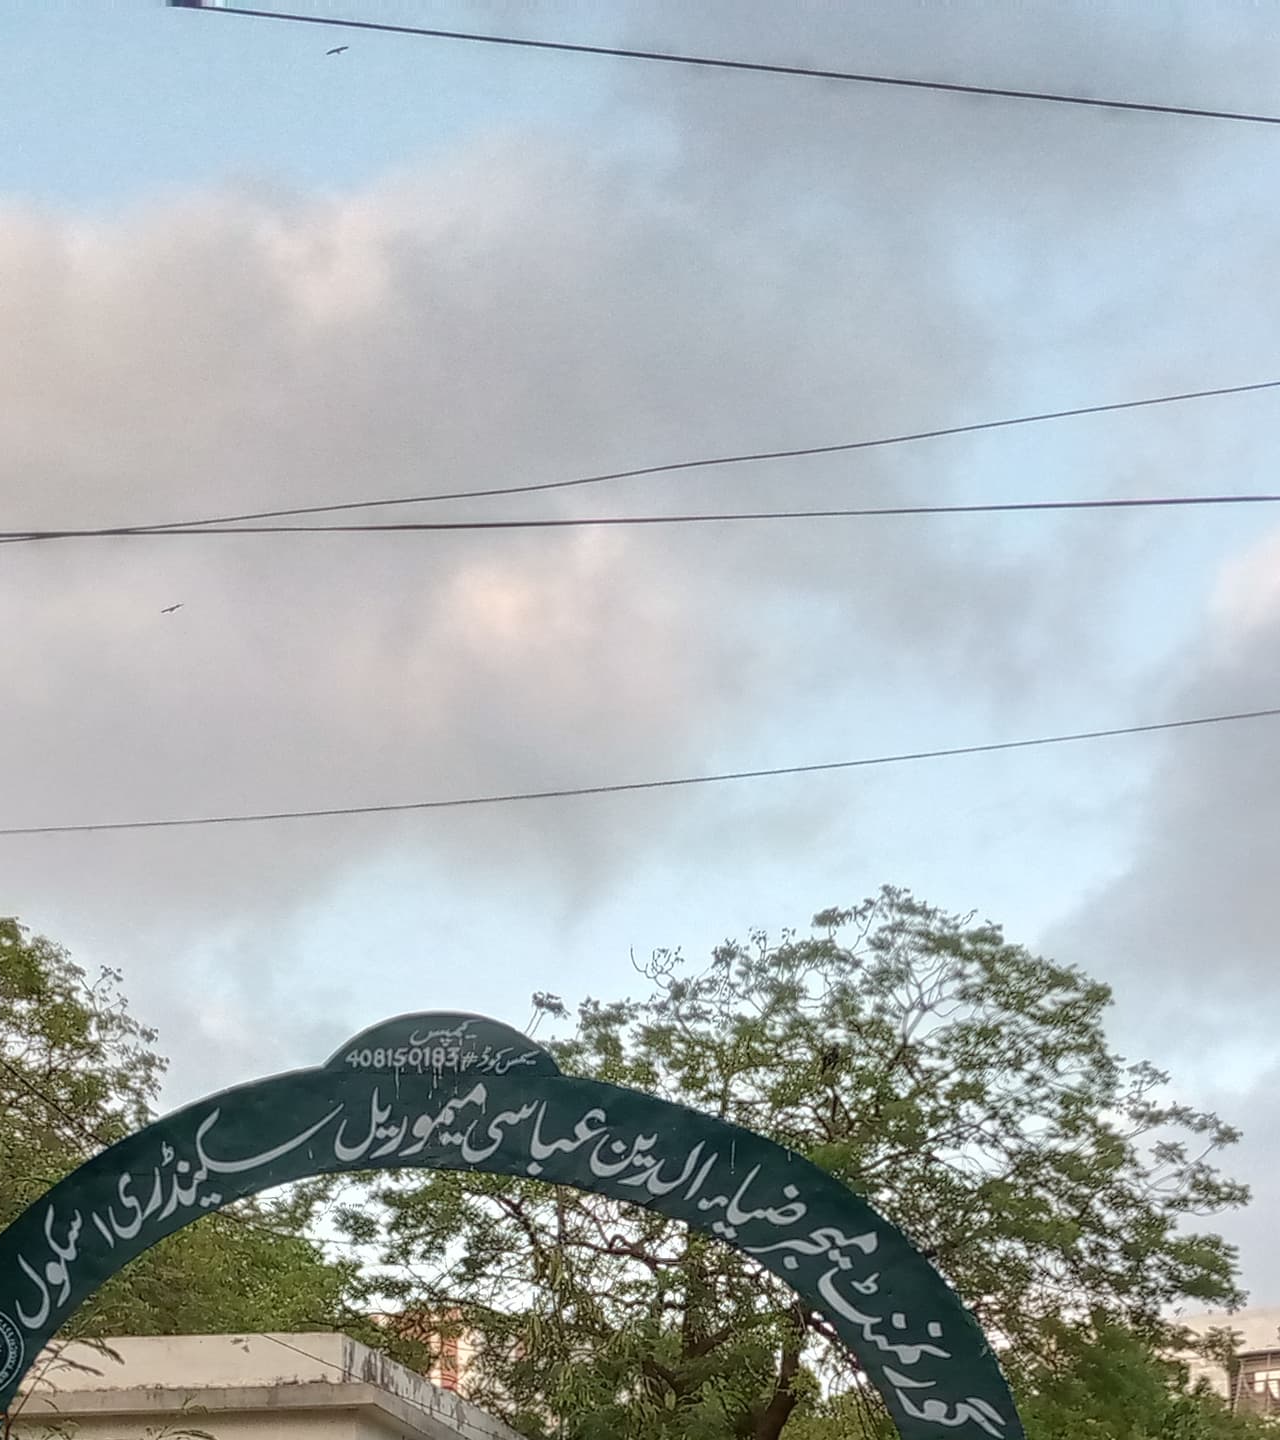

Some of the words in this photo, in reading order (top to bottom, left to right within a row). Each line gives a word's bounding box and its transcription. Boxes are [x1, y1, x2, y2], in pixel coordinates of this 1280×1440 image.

[334, 1082, 488, 1162] میموریل
[461, 1099, 607, 1175] عباسی
[589, 1133, 718, 1200] الدین
[743, 1227, 877, 1270] میجر
